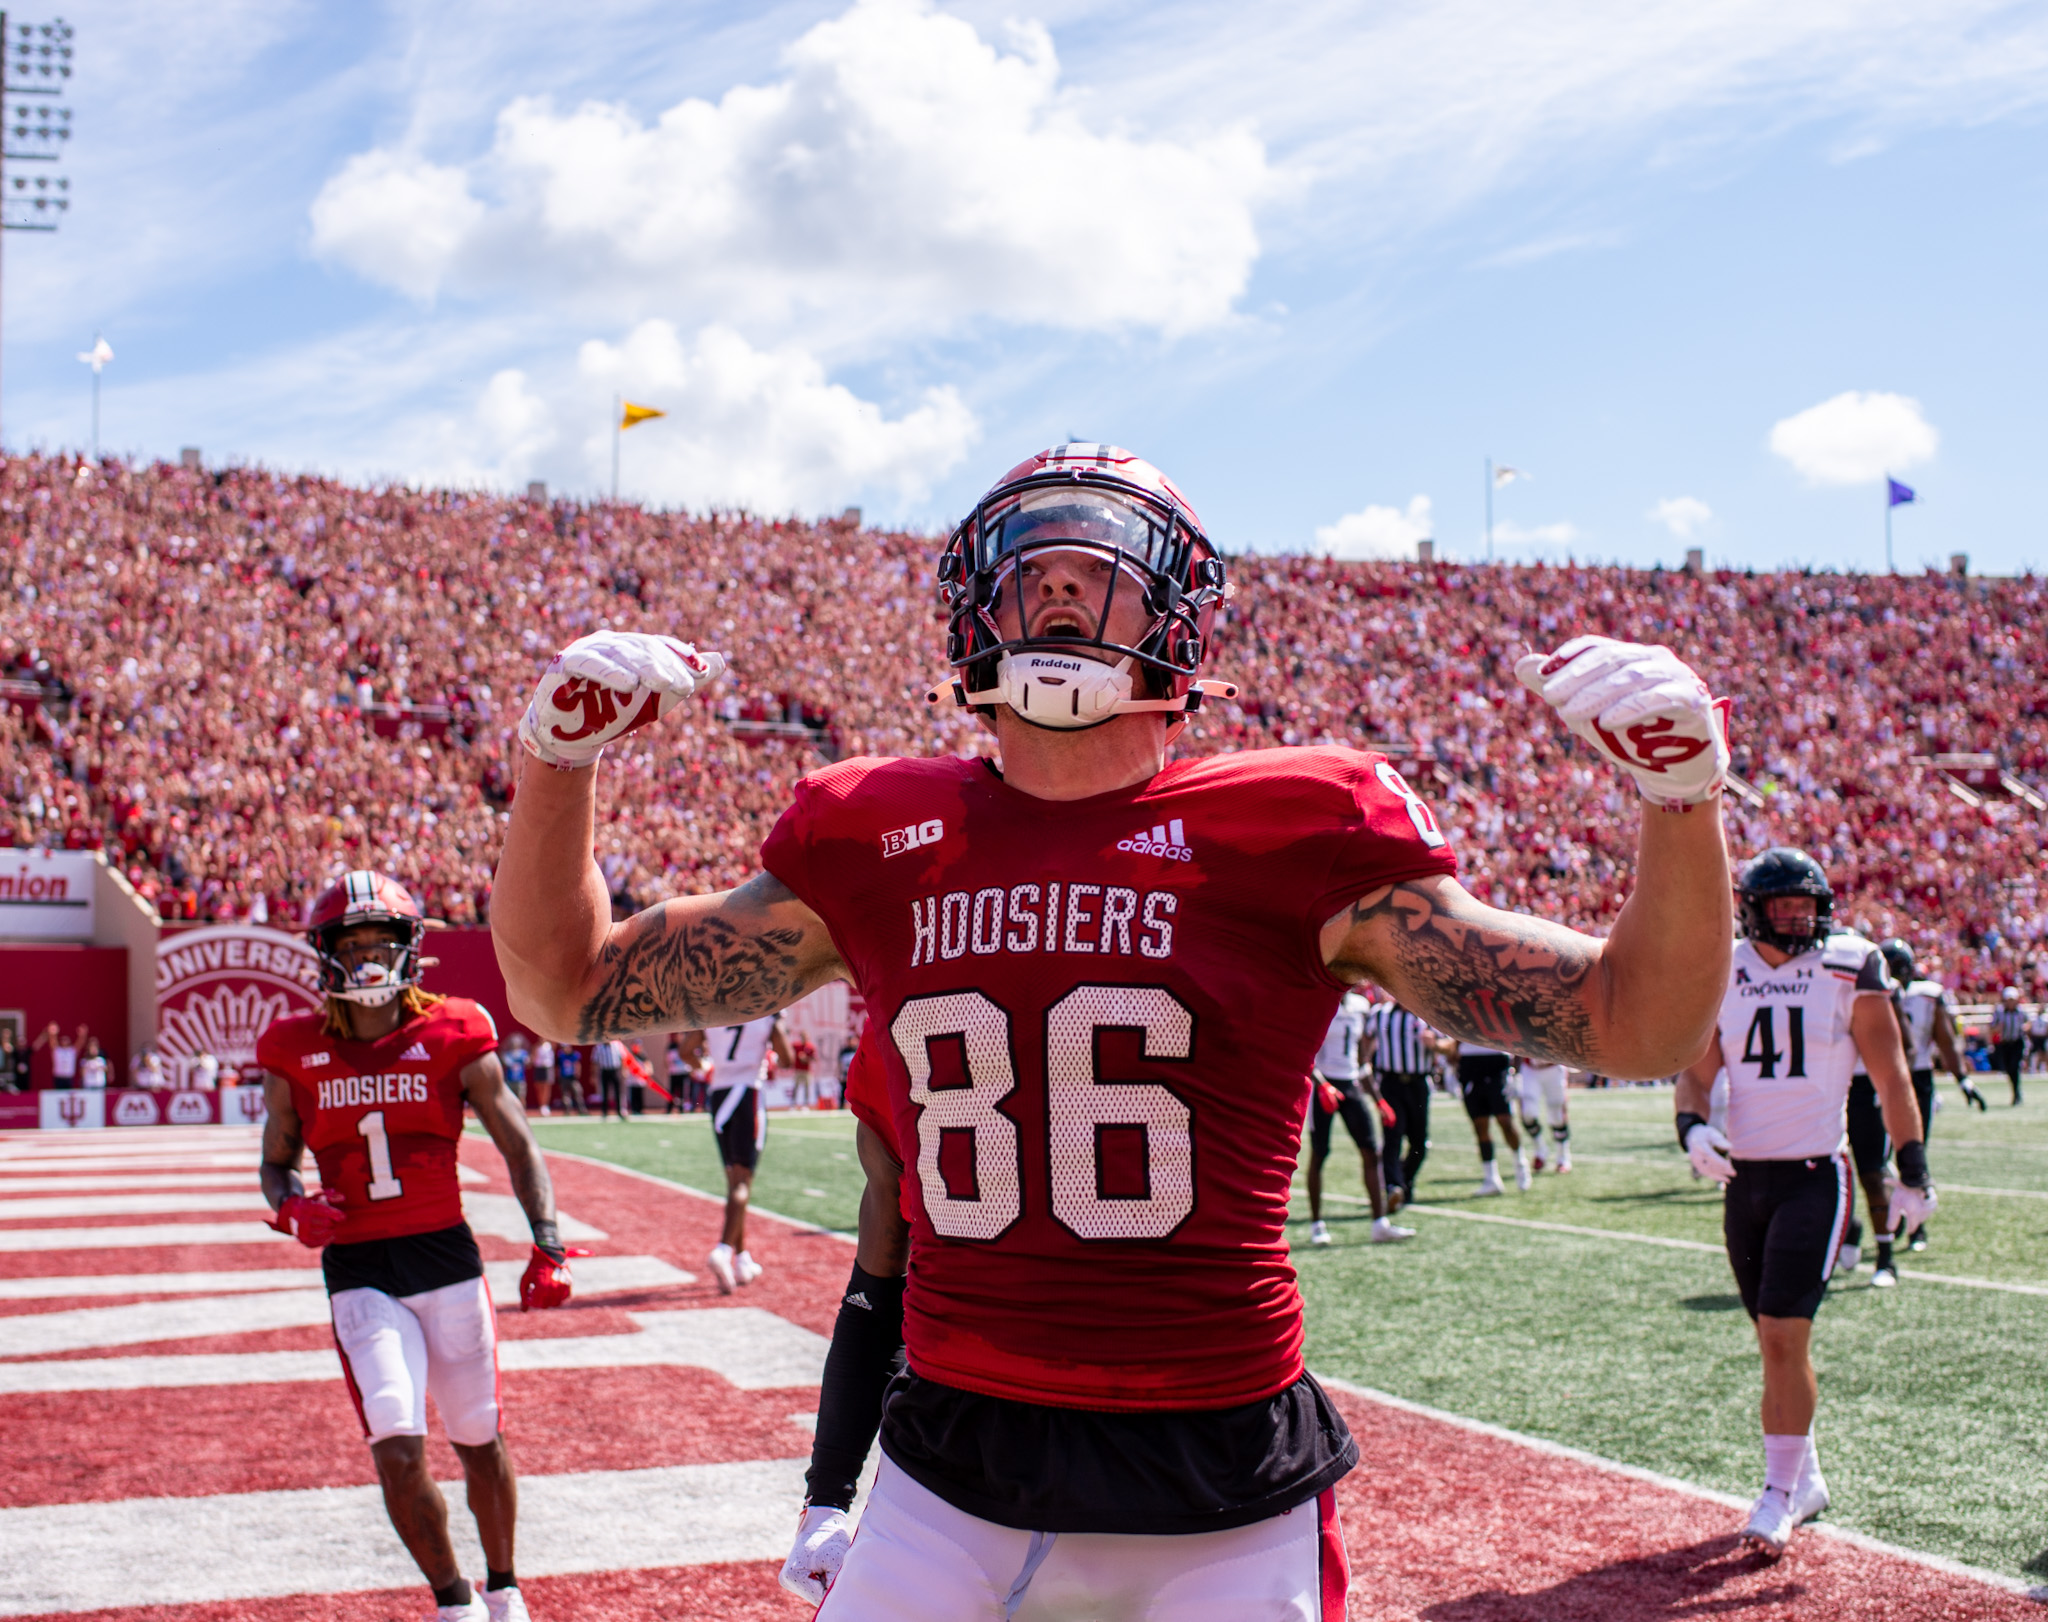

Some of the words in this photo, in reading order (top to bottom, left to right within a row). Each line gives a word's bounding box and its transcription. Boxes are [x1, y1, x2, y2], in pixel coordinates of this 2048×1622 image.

[1031, 658, 1081, 672] Riddell
[1117, 837, 1193, 862] adidas
[910, 881, 1178, 968] HOOSIERS
[156, 938, 319, 990] UNIVERSIT
[725, 1024, 744, 1061] 7
[1741, 1005, 1807, 1079] 41
[317, 1072, 428, 1110] HOOSIERS
[888, 982, 1198, 1244] 86
[357, 1111, 403, 1201] 1
